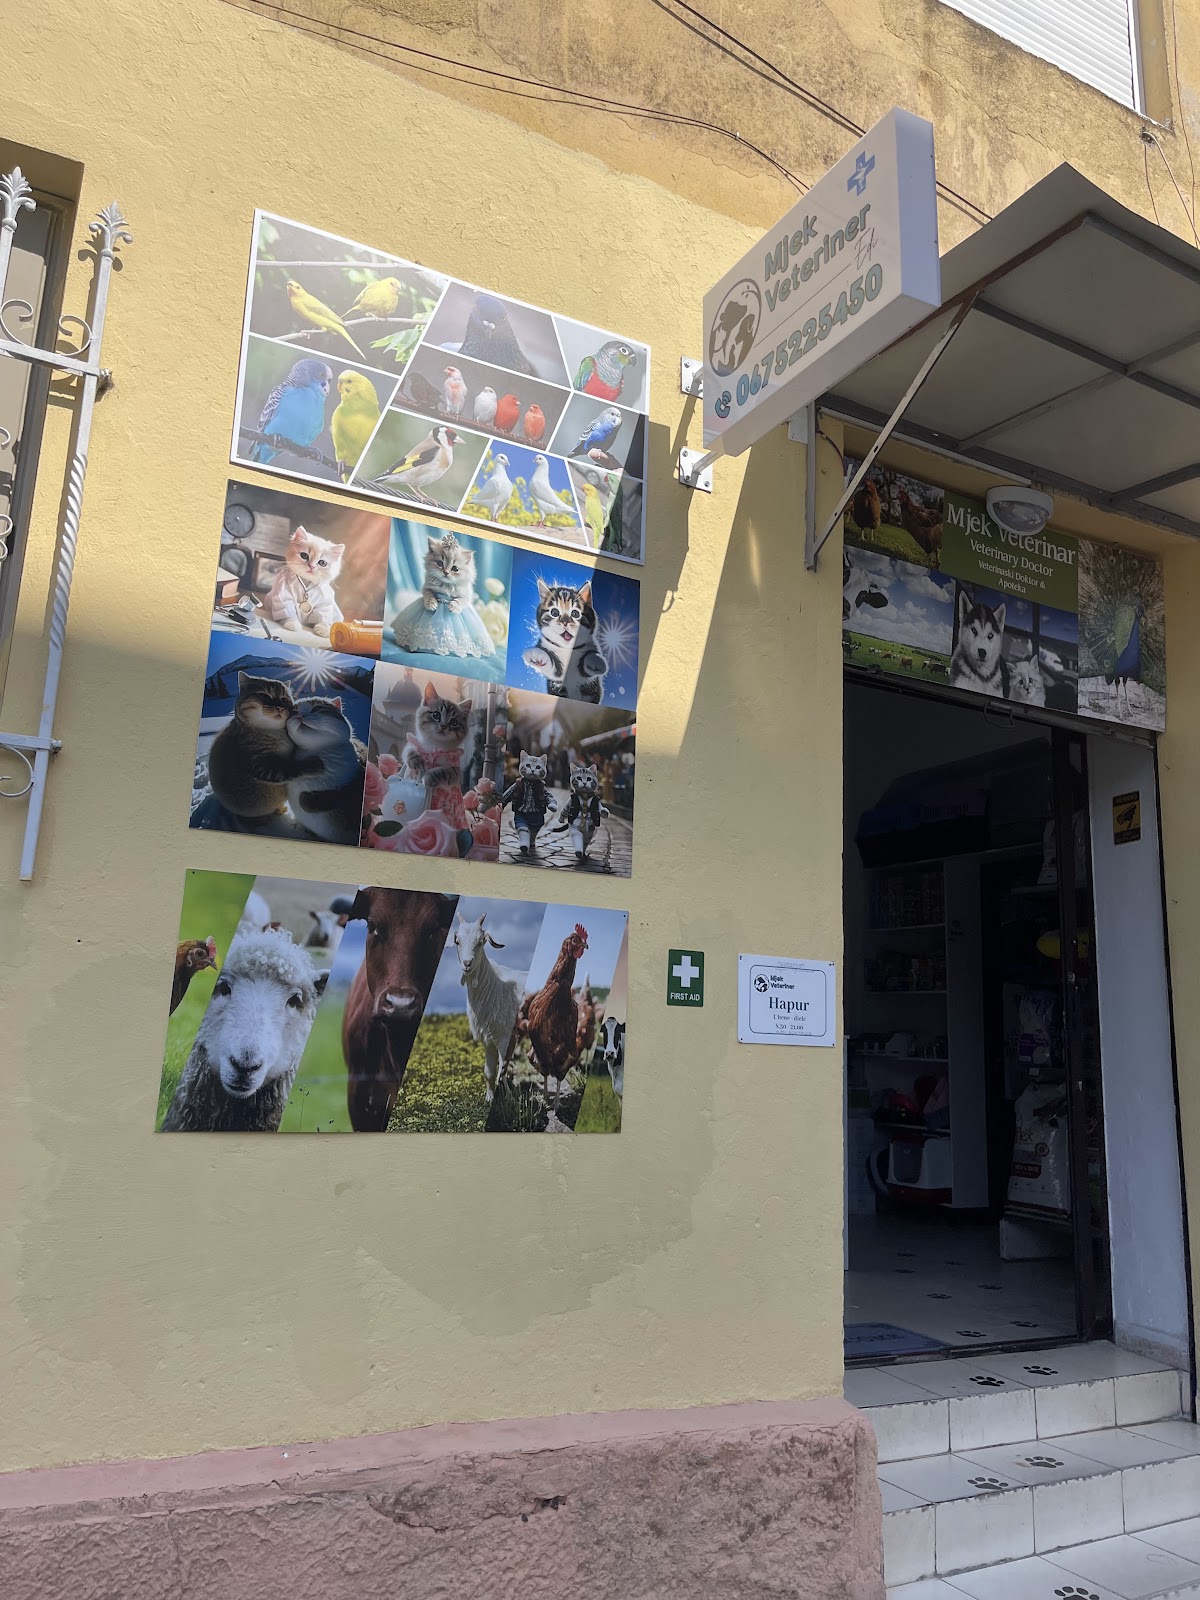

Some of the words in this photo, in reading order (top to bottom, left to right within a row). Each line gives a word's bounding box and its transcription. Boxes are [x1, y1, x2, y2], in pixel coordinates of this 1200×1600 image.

[764, 215, 818, 281] Mjek
[765, 204, 870, 312] Veteriner
[736, 263, 882, 407] 0675225450
[946, 503, 992, 538] Mjek
[999, 528, 1076, 565] Veterinar
[970, 538, 1019, 568] Veterinary
[1021, 557, 1054, 577] Doctor
[998, 578, 1026, 594] Apoteka
[1016, 572, 1039, 587] Doktor
[1040, 580, 1046, 589] &
[670, 992, 688, 1001] FIRST
[688, 993, 700, 1001] AID
[769, 996, 810, 1013] Hapur
